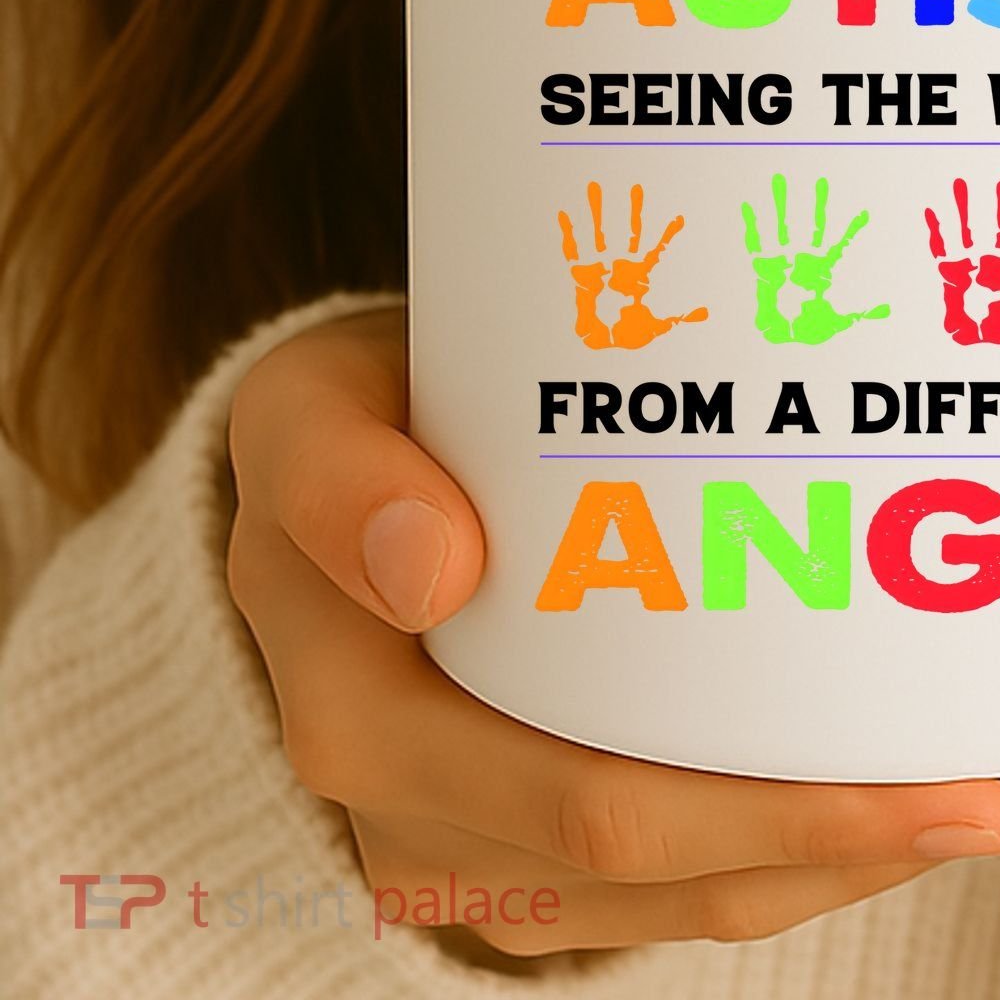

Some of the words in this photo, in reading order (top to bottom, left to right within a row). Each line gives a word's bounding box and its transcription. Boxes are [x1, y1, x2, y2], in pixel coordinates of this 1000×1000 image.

[540, 73, 793, 126] SEEING
[821, 73, 957, 126] THE
[537, 381, 735, 434] FROM
[764, 381, 821, 434] A
